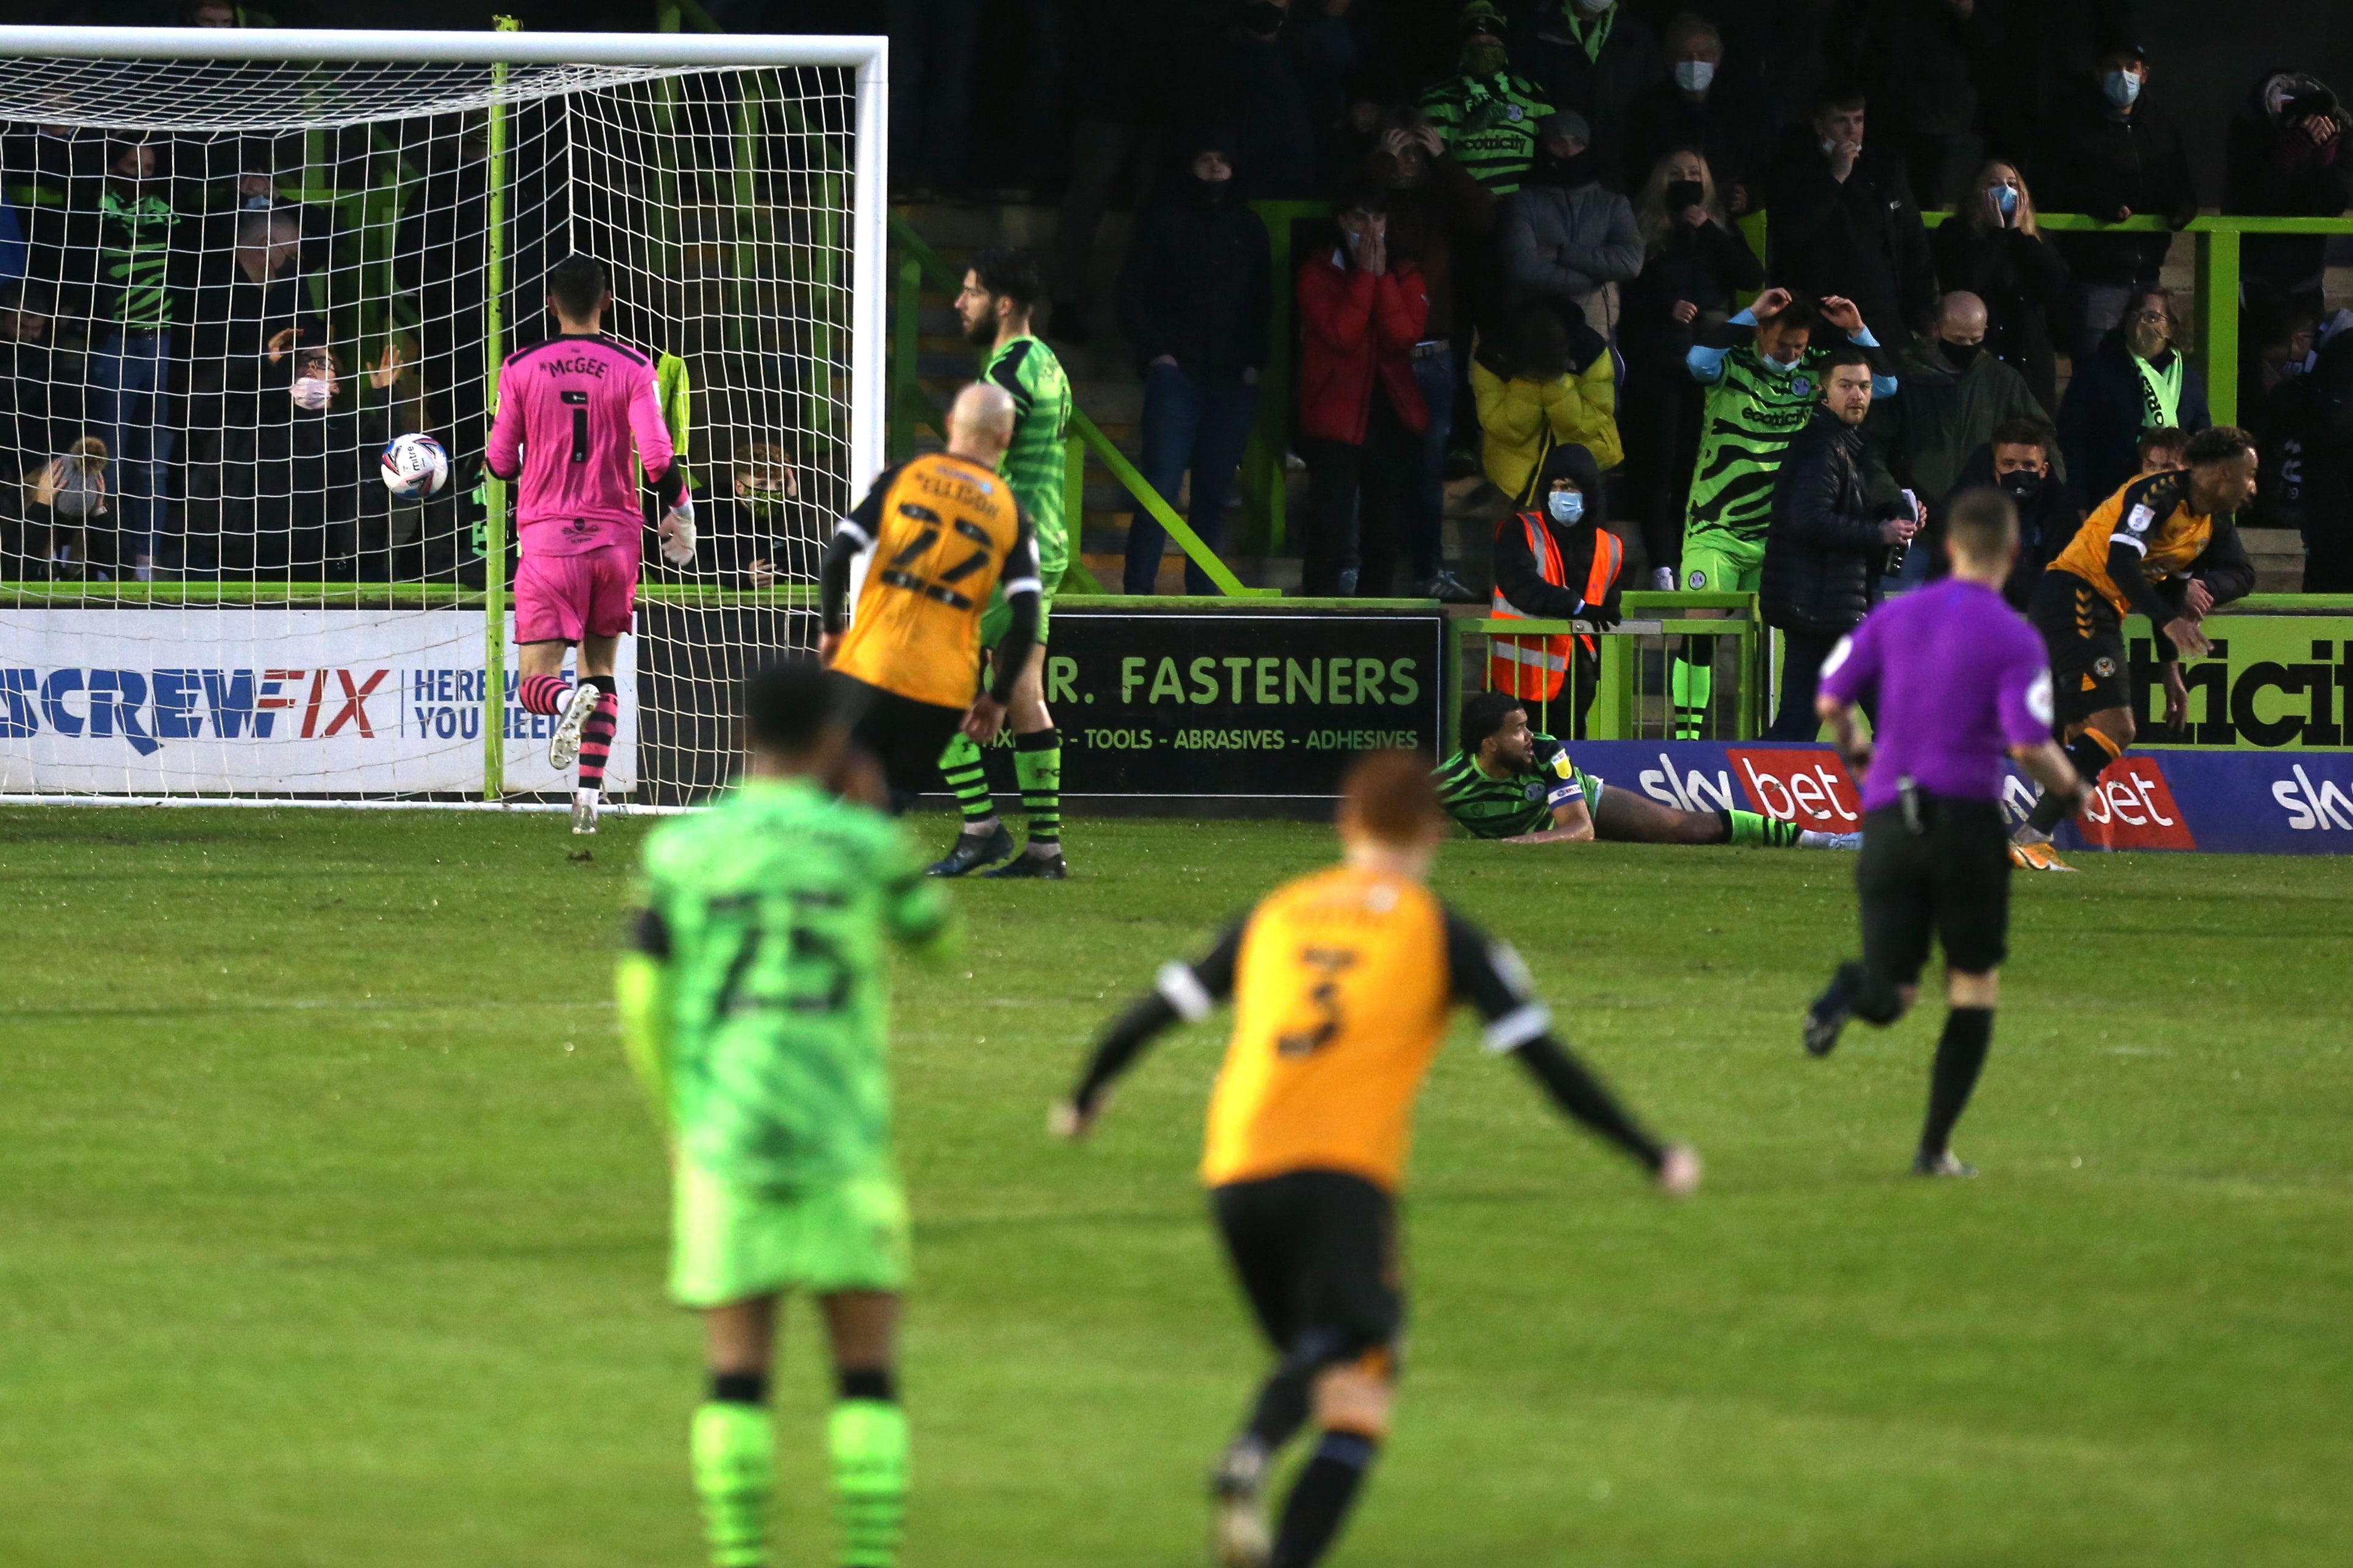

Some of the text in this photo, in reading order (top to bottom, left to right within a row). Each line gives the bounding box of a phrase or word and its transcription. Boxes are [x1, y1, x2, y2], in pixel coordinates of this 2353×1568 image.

[407, 445, 421, 471] mitre
[560, 391, 589, 464] 1
[880, 502, 995, 612] 22
[0, 669, 390, 756] SCREWFIX
[1122, 656, 1419, 705] FASTENERS
[414, 706, 479, 739] YOU
[1085, 729, 1153, 749] TOOLS
[1173, 730, 1285, 750] ABRASIVES
[1307, 730, 1417, 750] ADHESIVES
[1639, 753, 1858, 821] sky bet
[1276, 948, 1357, 1056] 3
